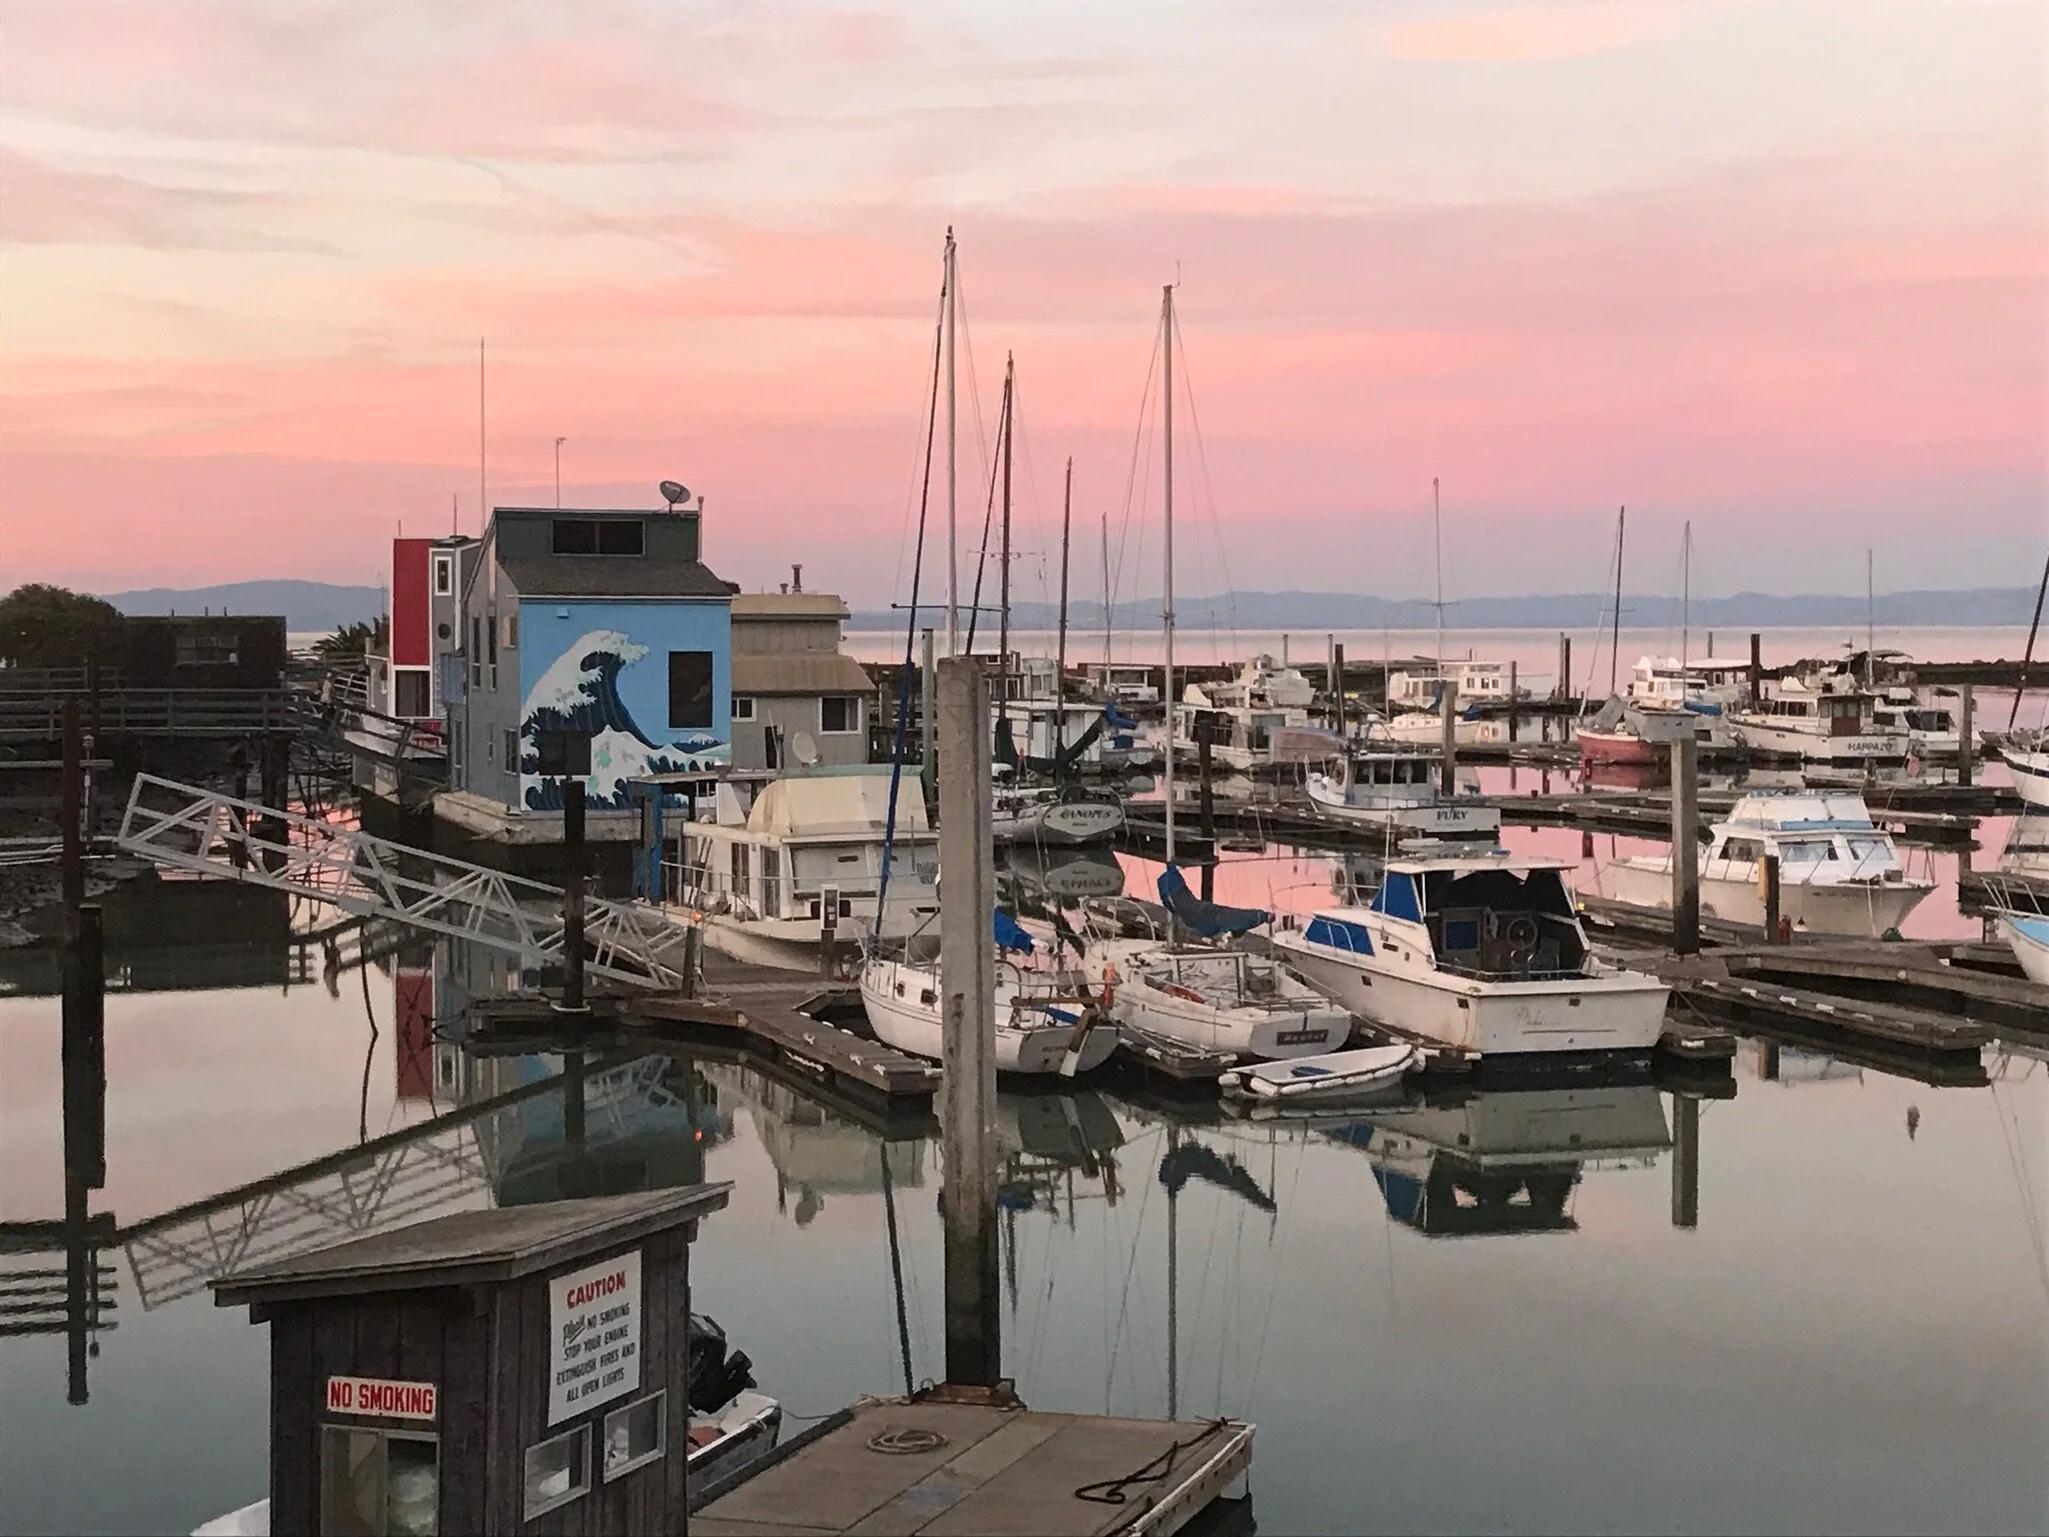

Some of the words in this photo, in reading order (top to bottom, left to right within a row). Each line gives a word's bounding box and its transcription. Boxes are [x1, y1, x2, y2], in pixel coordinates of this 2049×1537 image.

[1436, 810, 1468, 821] FURY
[566, 1271, 626, 1309] CAUTION
[587, 1315, 597, 1330] NO
[600, 1302, 631, 1325] SMOKING
[564, 1344, 581, 1361] STOP
[583, 1335, 601, 1352] YOUR
[604, 1324, 629, 1345] ENGINE
[556, 1358, 597, 1386] EXTINGUISH
[600, 1348, 619, 1368] FIRES
[621, 1342, 636, 1358] AND
[330, 1381, 352, 1408] NO
[359, 1383, 433, 1414] SMOKING
[566, 1386, 580, 1403] ALL
[581, 1378, 599, 1397] OPEN
[602, 1367, 625, 1387] LIGHTS
